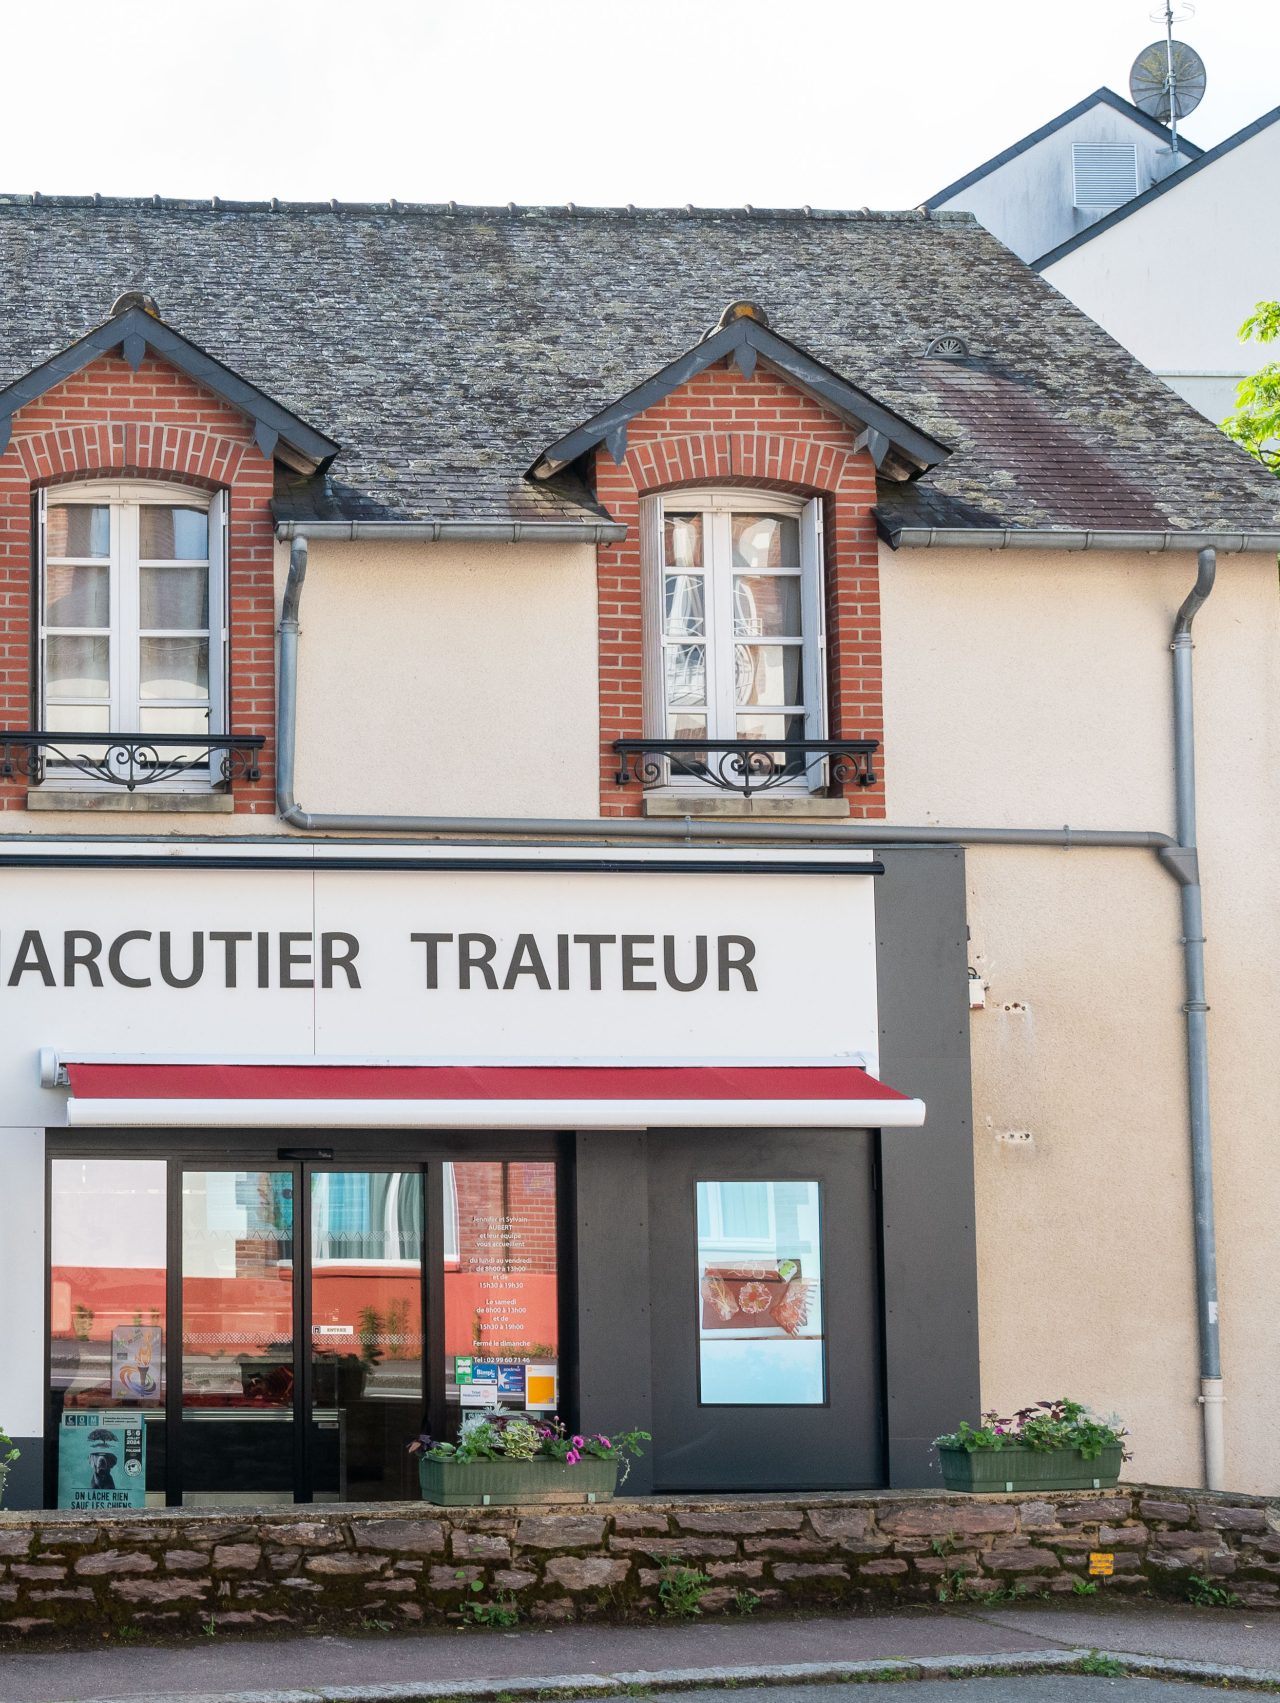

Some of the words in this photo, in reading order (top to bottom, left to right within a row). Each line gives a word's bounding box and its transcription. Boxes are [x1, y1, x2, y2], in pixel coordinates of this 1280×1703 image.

[410, 932, 759, 993] TRAITEUR
[75, 1492, 85, 1500] ON
[88, 1490, 109, 1501] LÂCHE
[113, 1492, 128, 1501] RIEN
